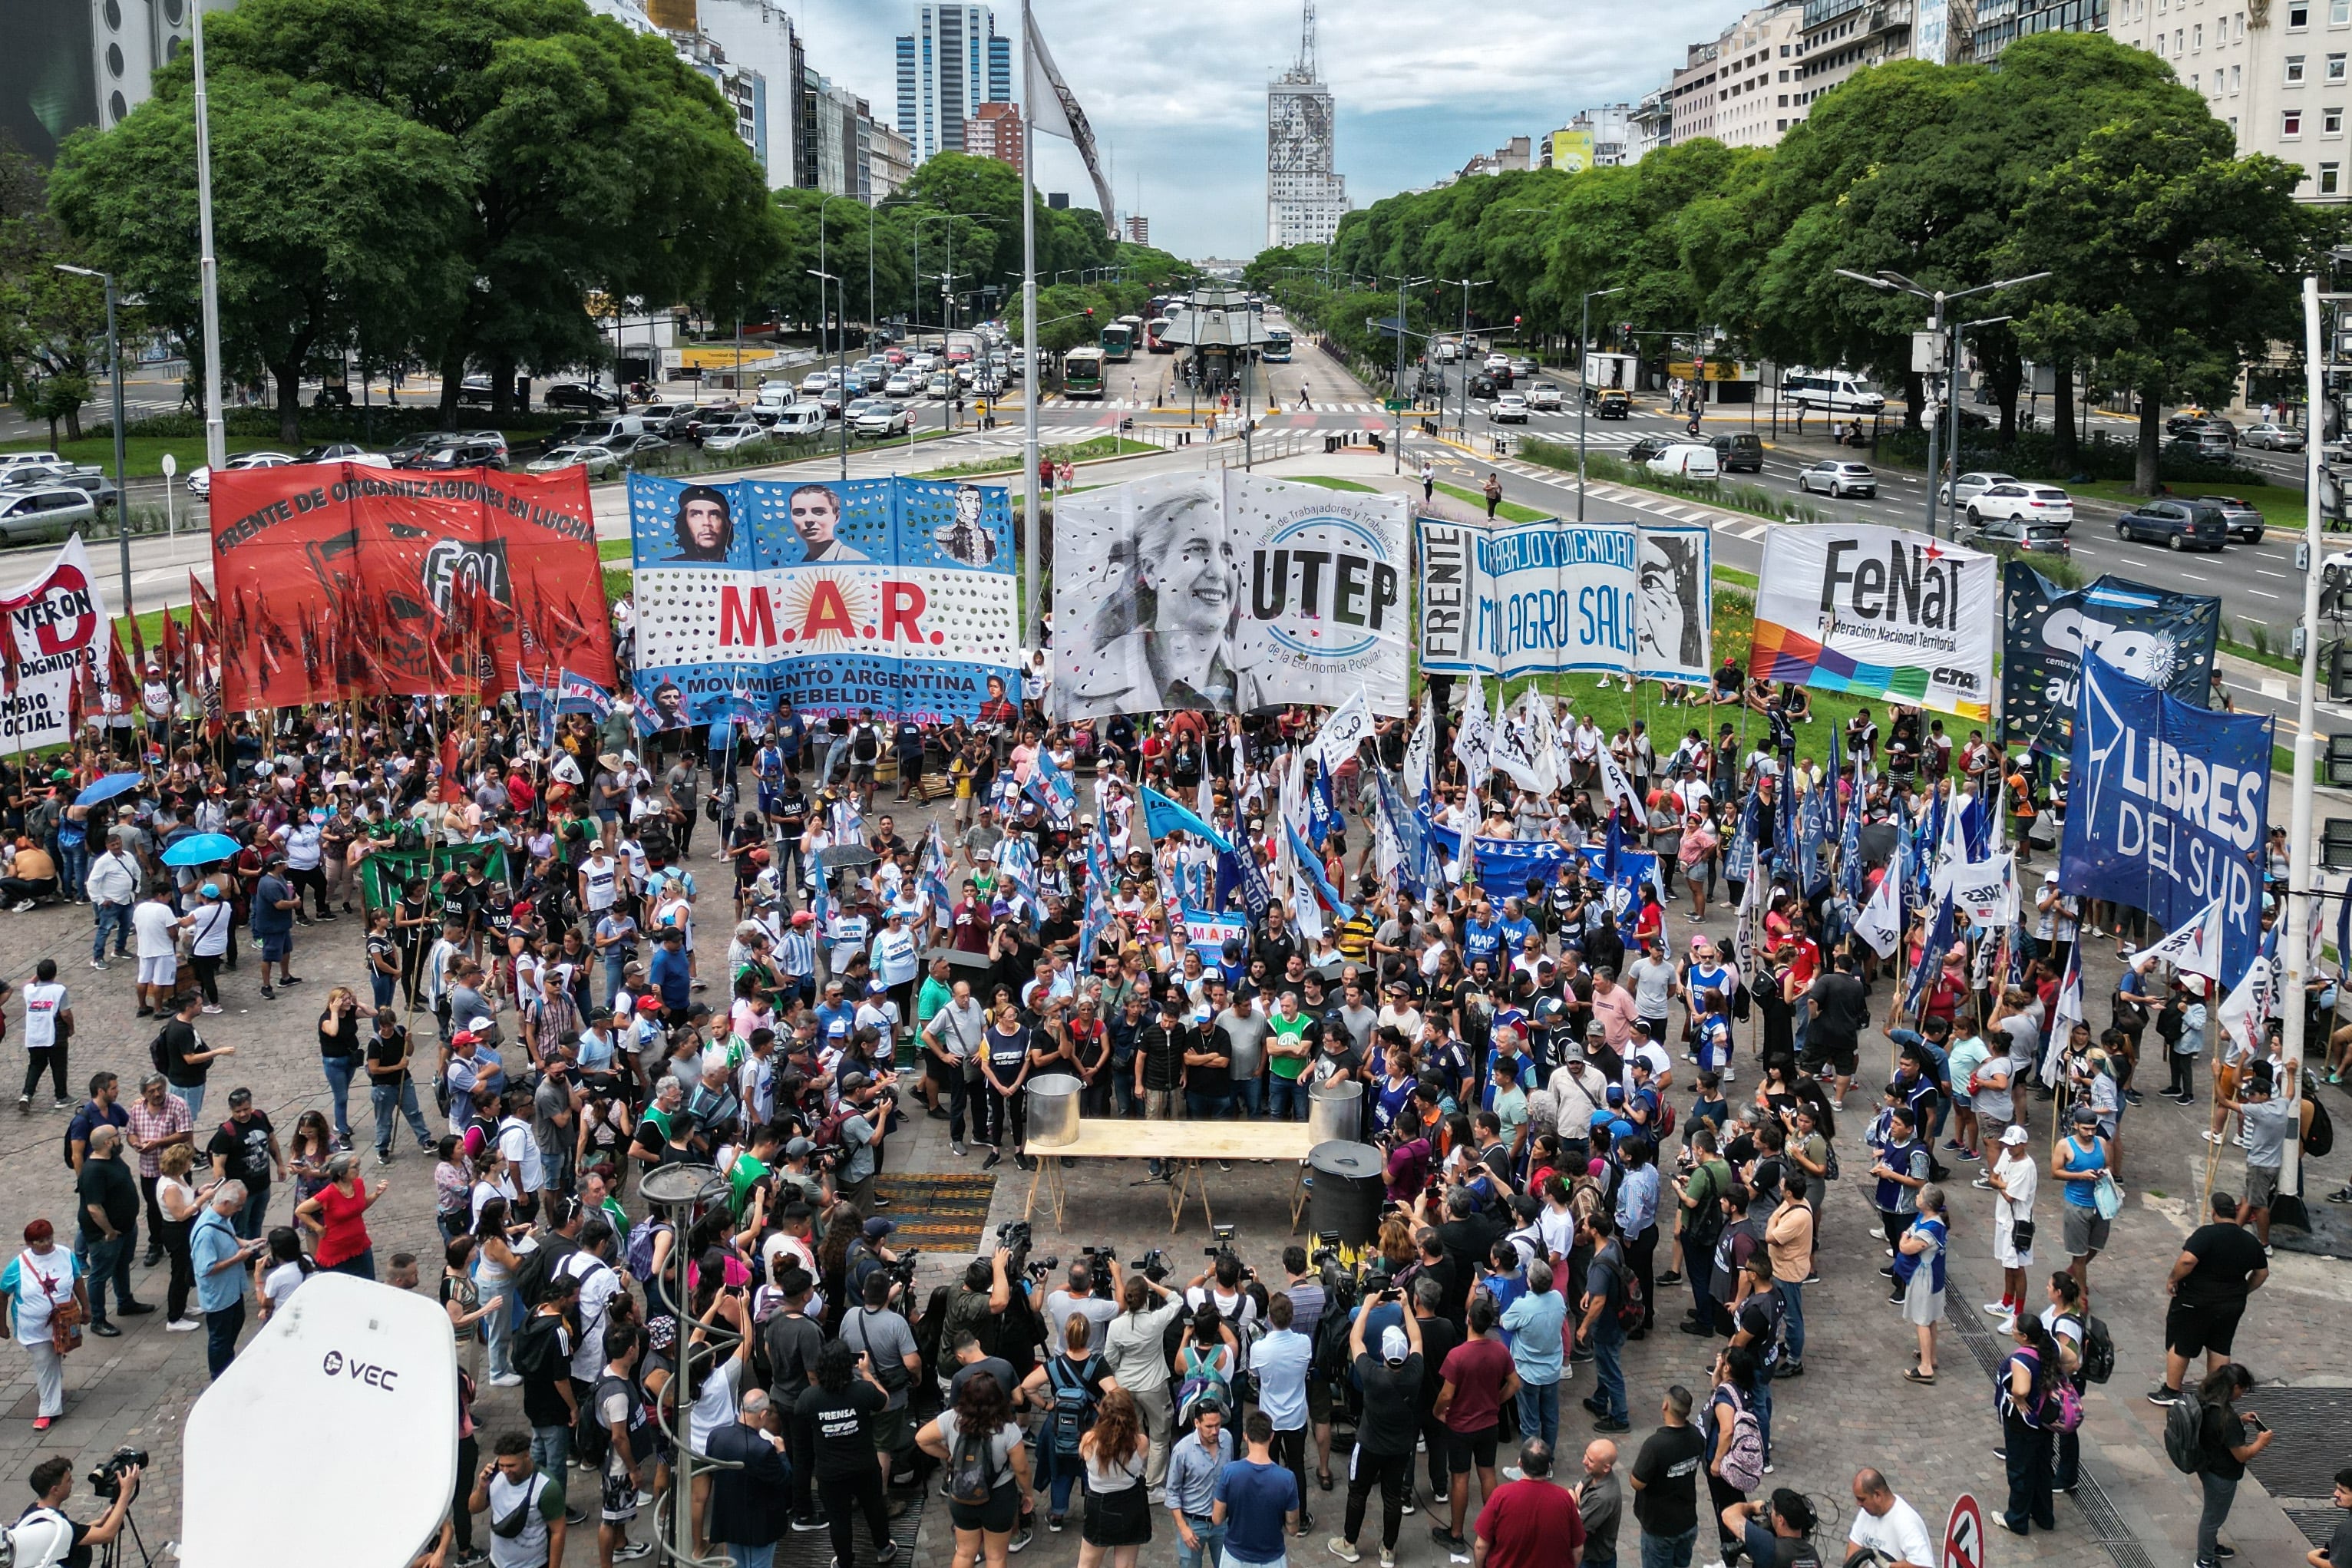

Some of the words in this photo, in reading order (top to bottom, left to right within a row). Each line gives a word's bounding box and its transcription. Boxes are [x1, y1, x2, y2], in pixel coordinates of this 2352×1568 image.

[216, 500, 294, 556] FRENTE
[295, 487, 329, 514] DE
[332, 479, 504, 510] ORGANIZACIONES
[507, 496, 530, 520] EN
[533, 506, 596, 546] LUCHA
[1257, 523, 1279, 547] Unión
[1277, 514, 1290, 527] de
[1289, 503, 1353, 520] Trabajadores
[1353, 510, 1361, 521] y
[1363, 512, 1396, 565] Trabajadoras
[1479, 531, 1543, 573] TRABAJO
[1544, 533, 1559, 566] Y
[1561, 530, 1637, 573] DIGNIDAD
[1252, 550, 1398, 631] UTEP
[1424, 527, 1462, 657] FRENTE
[12, 588, 94, 632] VERON
[719, 580, 945, 648] M.A.R.
[1478, 589, 1568, 659] MILAGRO
[1578, 584, 1638, 657] SALA
[1267, 642, 1280, 656] de
[1282, 652, 1290, 664] la
[1291, 655, 1347, 674] Economía
[1349, 649, 1382, 672] Popular
[1877, 626, 1918, 646] Nacional
[1919, 632, 1957, 652] Territorial
[687, 668, 834, 694] MOVMIENTO
[842, 669, 977, 692] ARGENTINA
[1932, 667, 1974, 690] CTA
[2046, 657, 2071, 669] central
[778, 688, 884, 707] REBELDE
[875, 709, 942, 724] ACCIÓN
[2122, 727, 2262, 850] LIBRES
[2117, 800, 2181, 883] DEL
[2188, 838, 2251, 936] SUR
[446, 900, 462, 913] MAR
[1245, 878, 1264, 916] SUR
[1469, 933, 1495, 949] MAP
[1739, 930, 1752, 973] SUR
[350, 1358, 398, 1391] VEC
[818, 1408, 857, 1421] PRENSA
